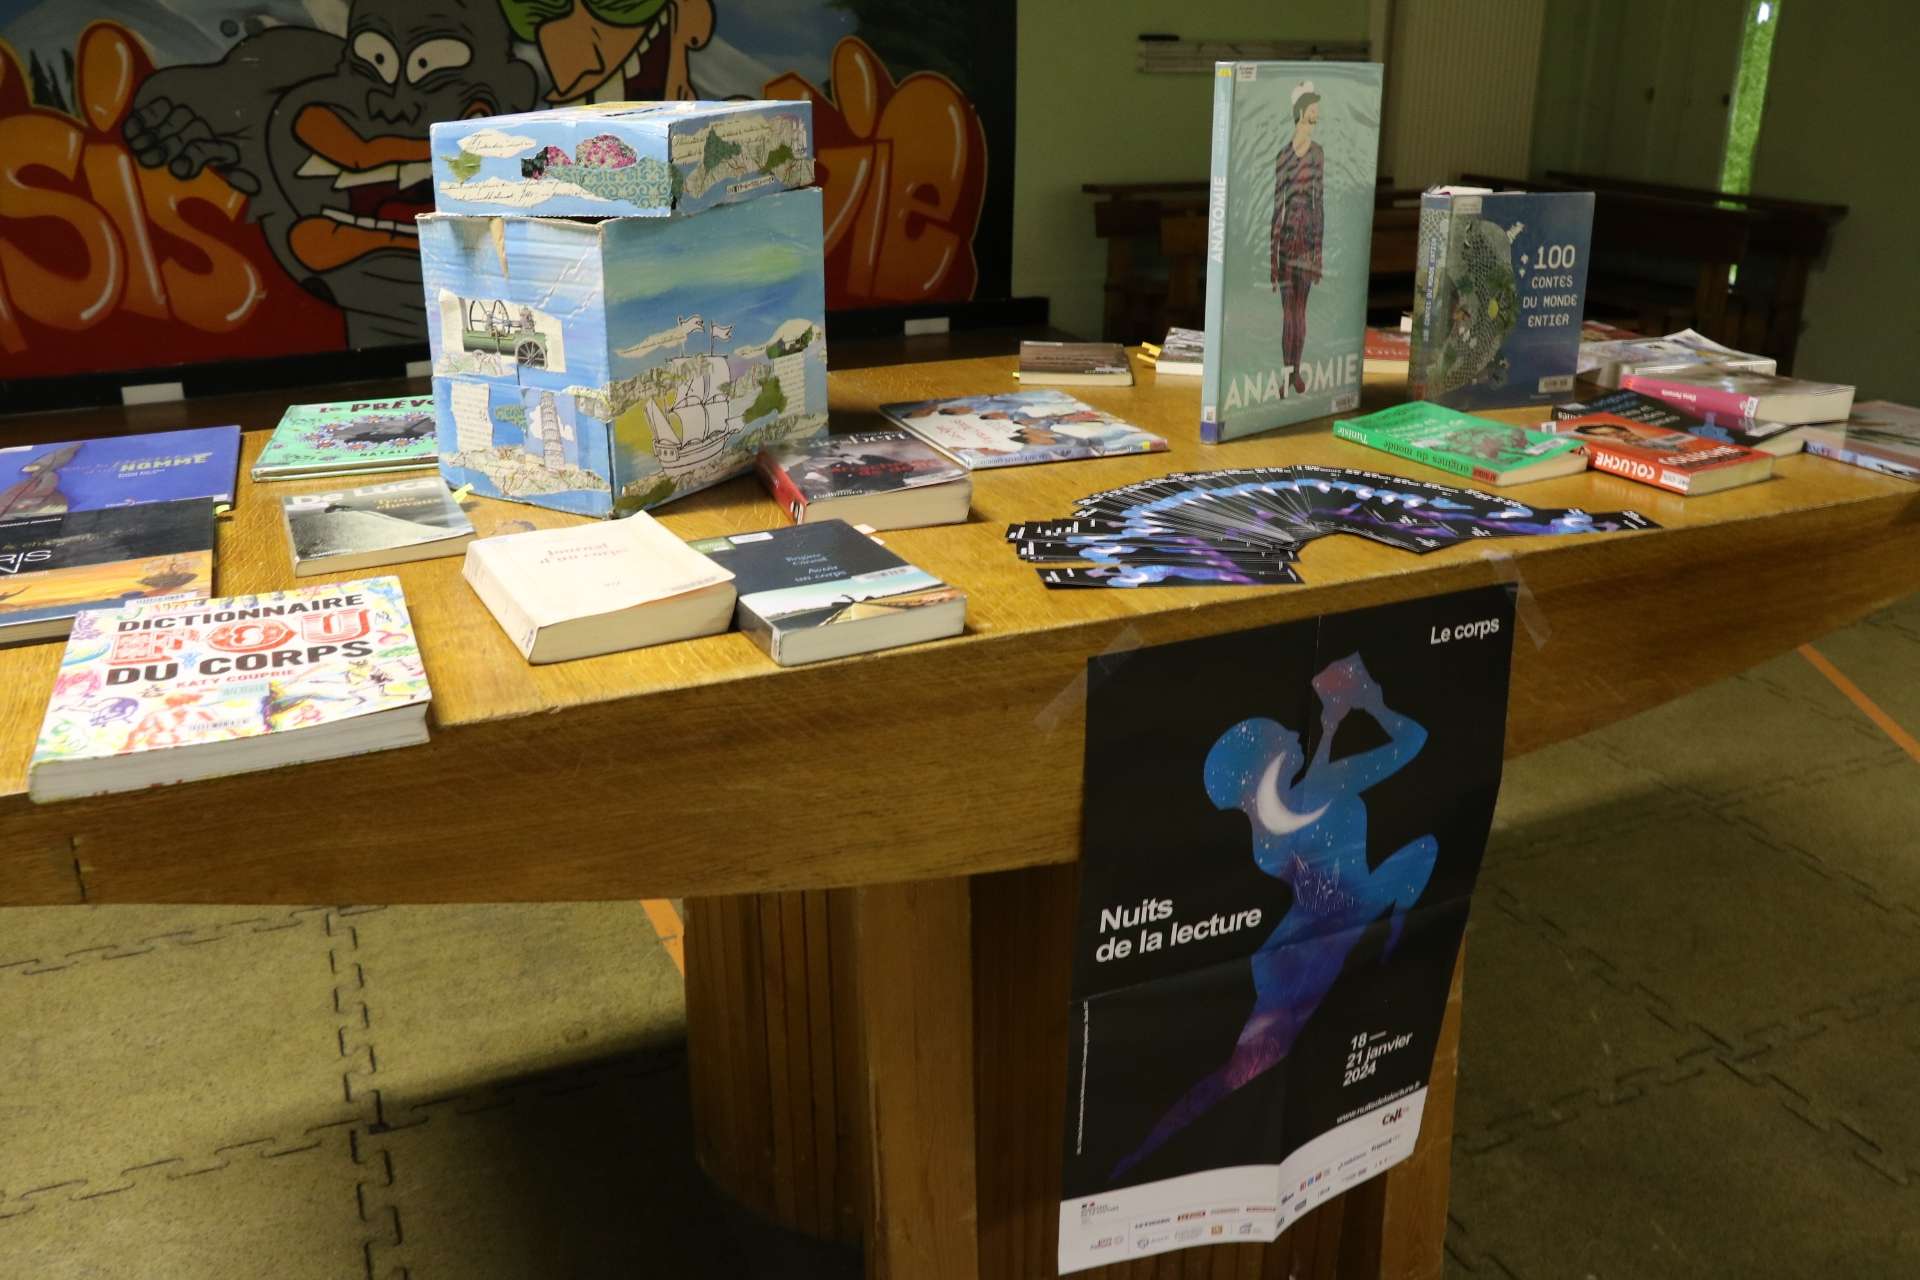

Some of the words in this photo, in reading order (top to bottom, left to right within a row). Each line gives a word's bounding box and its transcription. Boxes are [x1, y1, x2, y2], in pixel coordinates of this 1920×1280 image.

[1210, 175, 1228, 264] ANATOMIE
[1533, 244, 1577, 270] 100
[1531, 275, 1573, 289] CONTES
[1523, 296, 1538, 309] DU
[1543, 294, 1578, 307] MONDE
[1527, 313, 1570, 328] ENTIER
[1224, 352, 1358, 410] ANATOMIE
[1337, 426, 1368, 445] Tunisie
[1594, 451, 1656, 480] COLUCHE
[117, 593, 366, 633] DICTIONNAIRE
[106, 608, 371, 665] FOU
[1430, 625, 1451, 645] Le
[1454, 617, 1500, 641] corps
[105, 661, 179, 686] DU
[199, 640, 374, 676] CORPS
[176, 678, 220, 689] KATY
[226, 668, 295, 683] COUPRIE
[1099, 897, 1174, 934] Nuits
[1095, 936, 1133, 963] de
[1138, 928, 1163, 954] la
[1170, 907, 1263, 947] lecture
[1345, 1050, 1363, 1070] 21
[1363, 1032, 1414, 1066] janvier
[1350, 1032, 1368, 1052] 18
[1343, 1060, 1377, 1088] 2024
